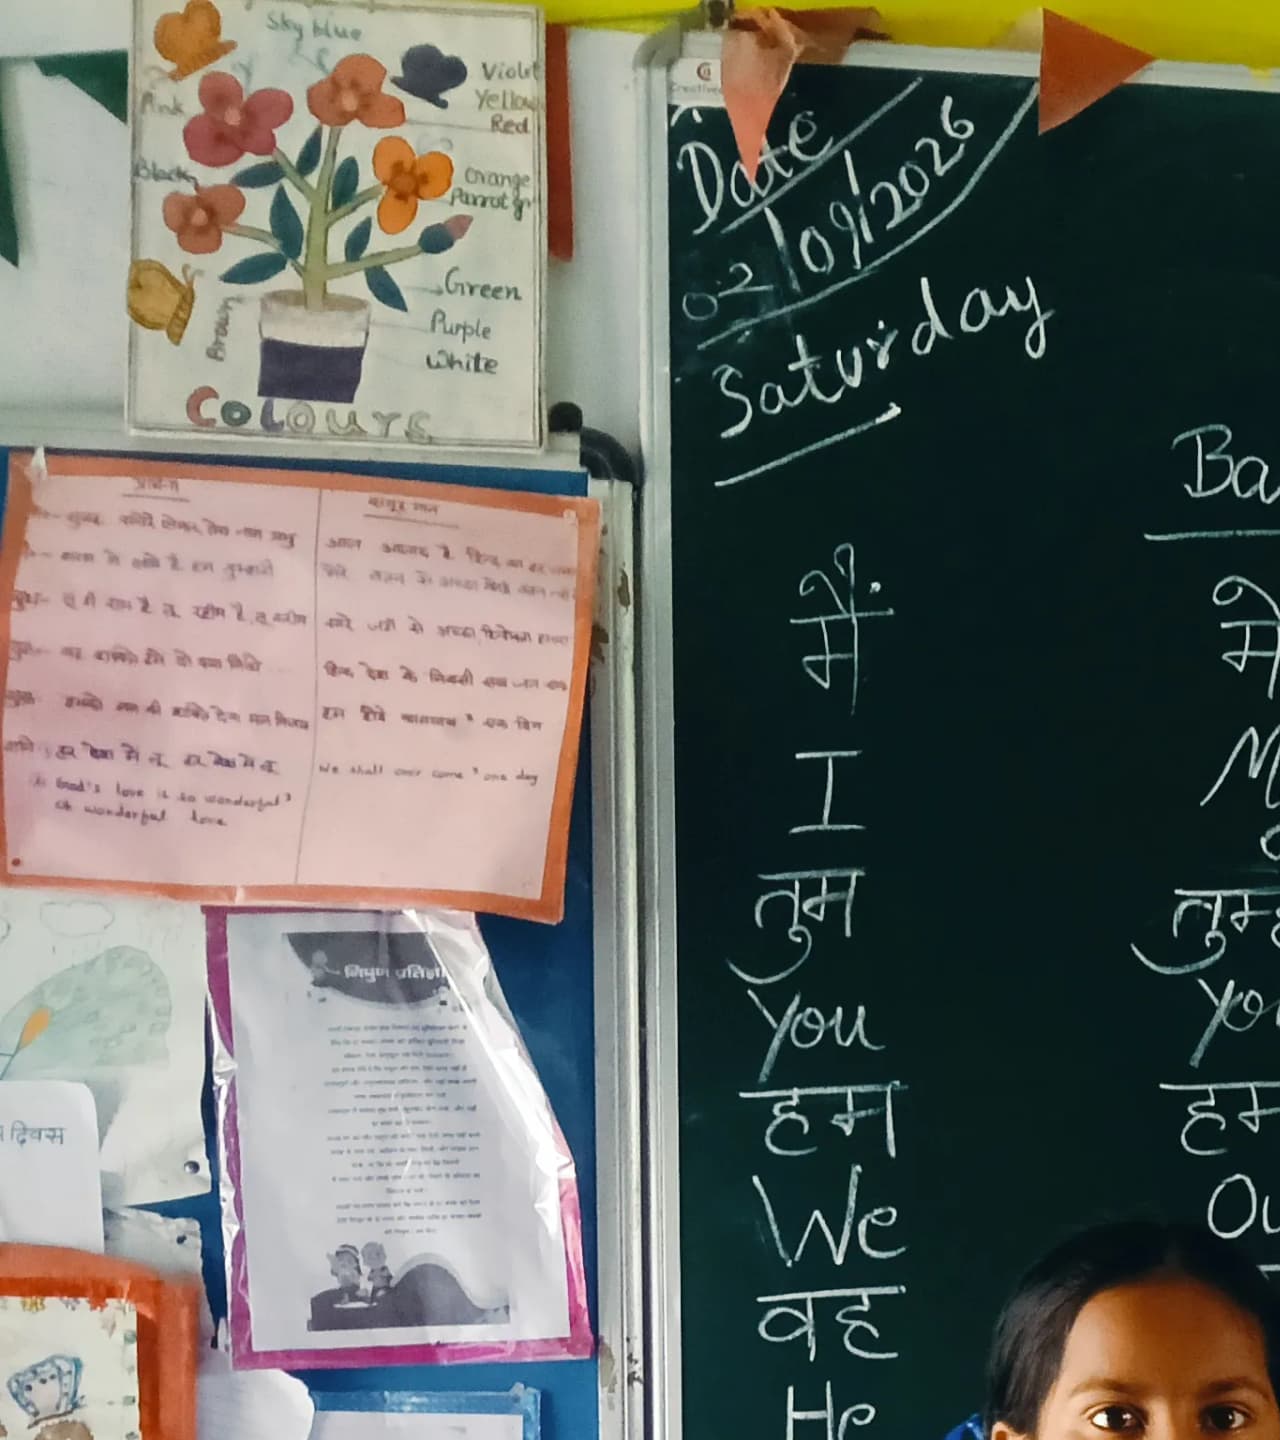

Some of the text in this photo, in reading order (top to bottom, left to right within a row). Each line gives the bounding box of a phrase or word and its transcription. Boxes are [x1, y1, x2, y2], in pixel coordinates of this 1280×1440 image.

[444, 266, 523, 301] Green
[711, 277, 1055, 438] Saturday
[790, 543, 894, 717] मैं
[789, 750, 867, 834] I
[727, 867, 866, 985] तुम
[747, 989, 886, 1084] You
[739, 1079, 909, 1158] हम
[752, 1164, 907, 1268] We
[756, 1285, 907, 1362] वह
